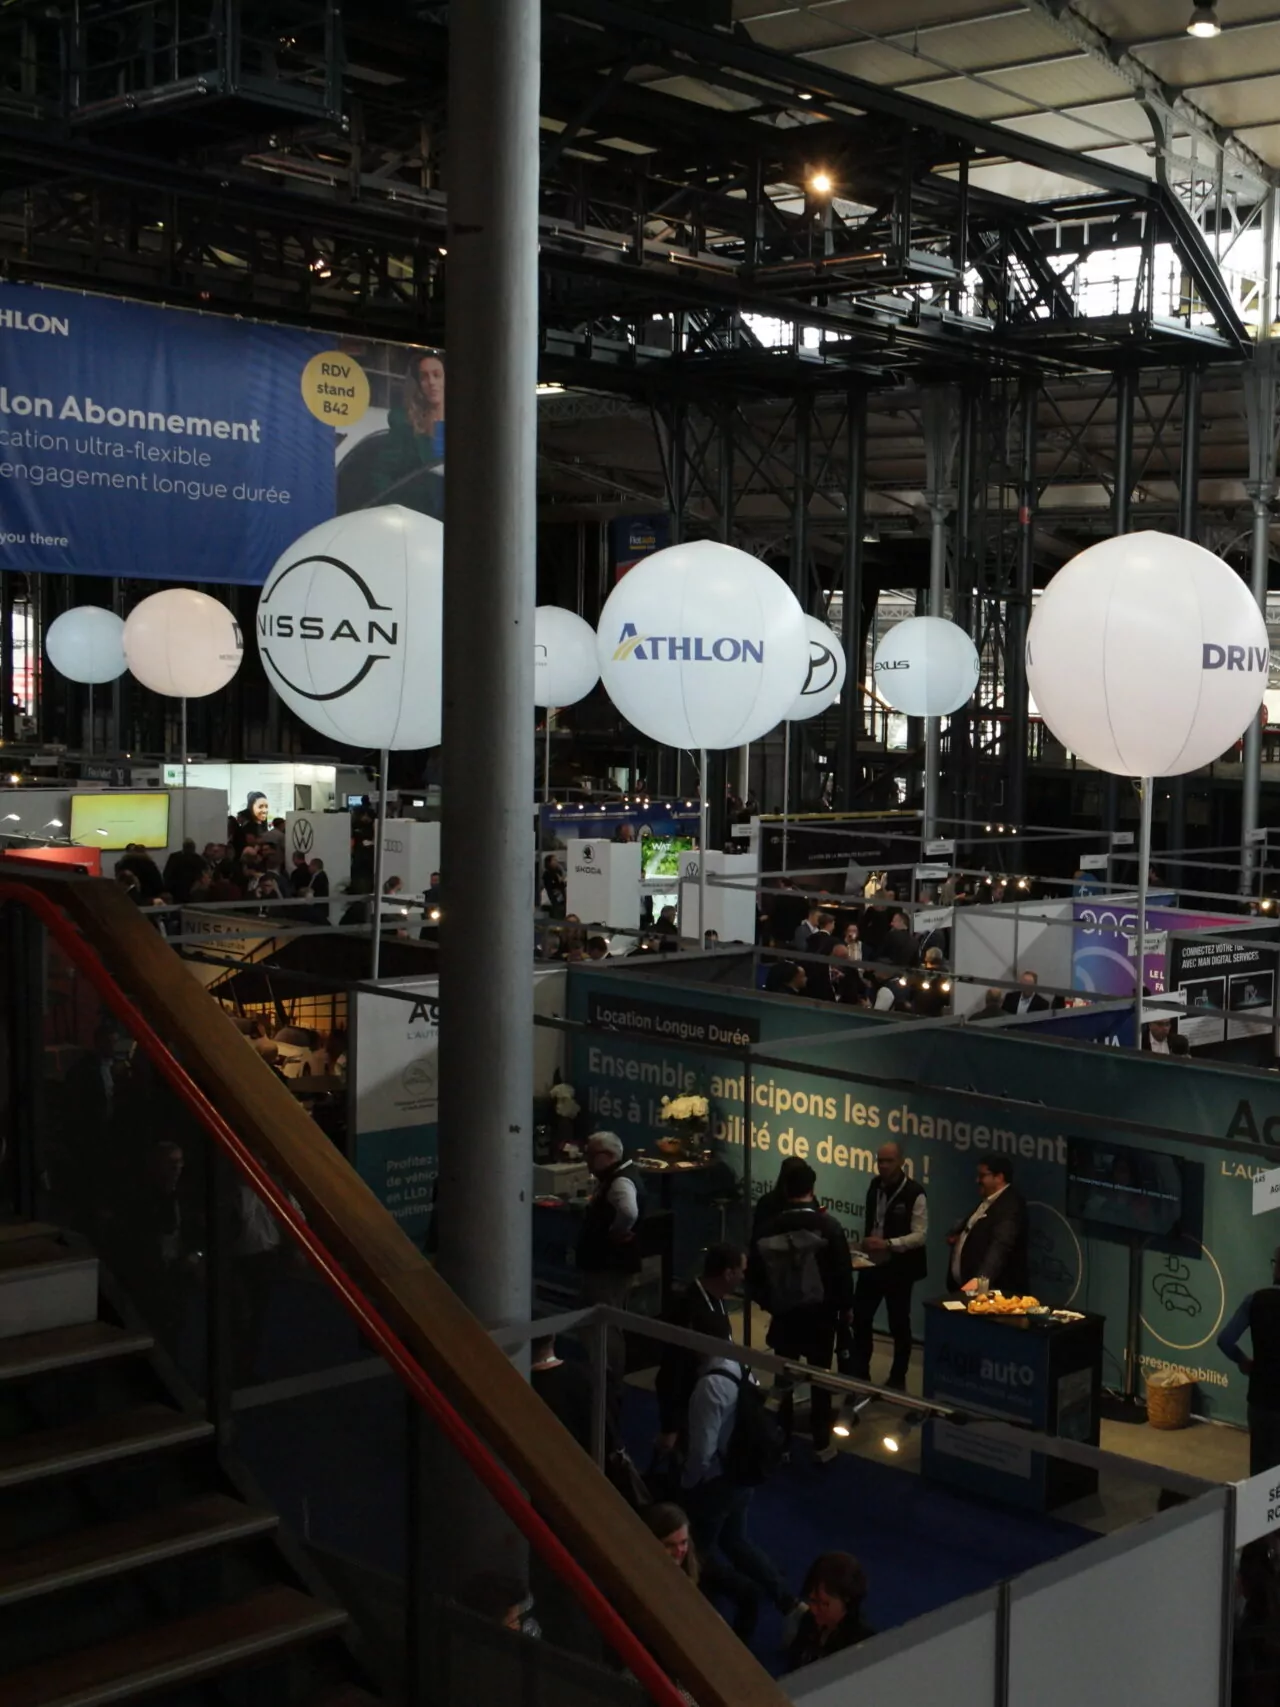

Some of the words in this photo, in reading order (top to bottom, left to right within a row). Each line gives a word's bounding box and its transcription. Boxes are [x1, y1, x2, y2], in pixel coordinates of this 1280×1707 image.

[321, 363, 351, 379] RDV
[317, 382, 355, 398] stand
[59, 395, 260, 444] Abonnement
[323, 401, 349, 416] B42
[75, 435, 212, 467] ultra-flexible
[0, 462, 148, 491] engagement
[153, 476, 227, 501] longue
[233, 483, 291, 504] durée
[0, 533, 26, 545] you
[30, 532, 69, 547] there
[257, 613, 398, 645] NISSAN
[612, 623, 764, 663] ATHLON
[1181, 958, 1197, 969] AVEC
[1197, 956, 1211, 968] MAN
[1211, 954, 1232, 966] DIGITAL
[596, 1005, 651, 1030] Location
[655, 1016, 705, 1041] Longue
[708, 1023, 750, 1047] Durée
[588, 1047, 697, 1091] Ensemble
[709, 1074, 837, 1120] anticipons
[844, 1093, 880, 1129] les
[887, 1104, 1068, 1166] changement
[588, 1086, 623, 1121] liés
[627, 1093, 641, 1124] à
[709, 1112, 771, 1152] bilité
[777, 1127, 809, 1159] de
[922, 1154, 931, 1185] !
[386, 1154, 432, 1173] Profitez
[386, 1176, 402, 1188] de
[404, 1186, 427, 1201] LLD
[821, 1195, 867, 1218] mesur
[1123, 1347, 1230, 1389] oresponsabilité
